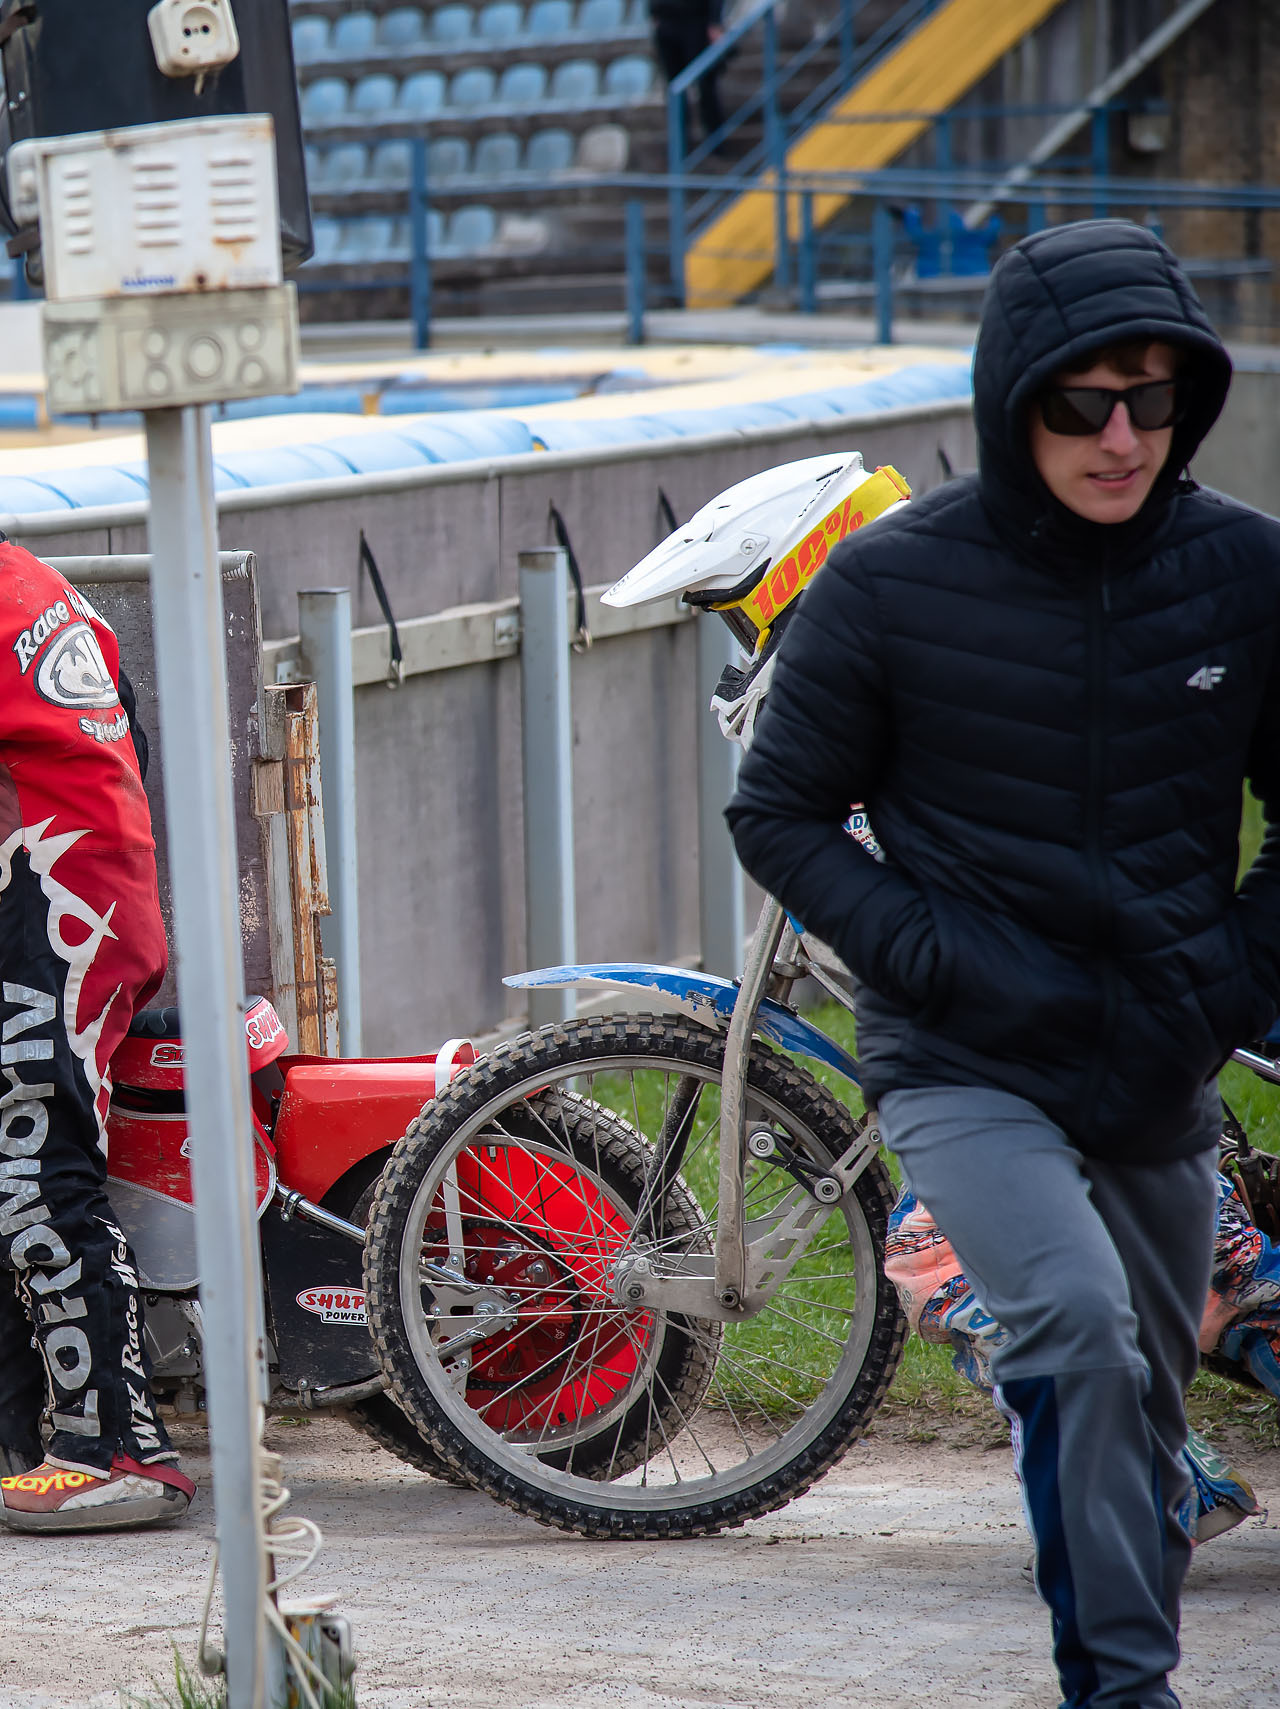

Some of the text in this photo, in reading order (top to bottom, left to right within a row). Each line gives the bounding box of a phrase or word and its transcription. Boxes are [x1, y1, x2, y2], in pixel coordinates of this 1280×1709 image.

[752, 498, 864, 621] 100%
[12, 600, 70, 676] Race
[1186, 665, 1227, 690] 4F
[121, 1294, 148, 1380] Race
[325, 1311, 366, 1322] POWER
[124, 1383, 161, 1451] WK
